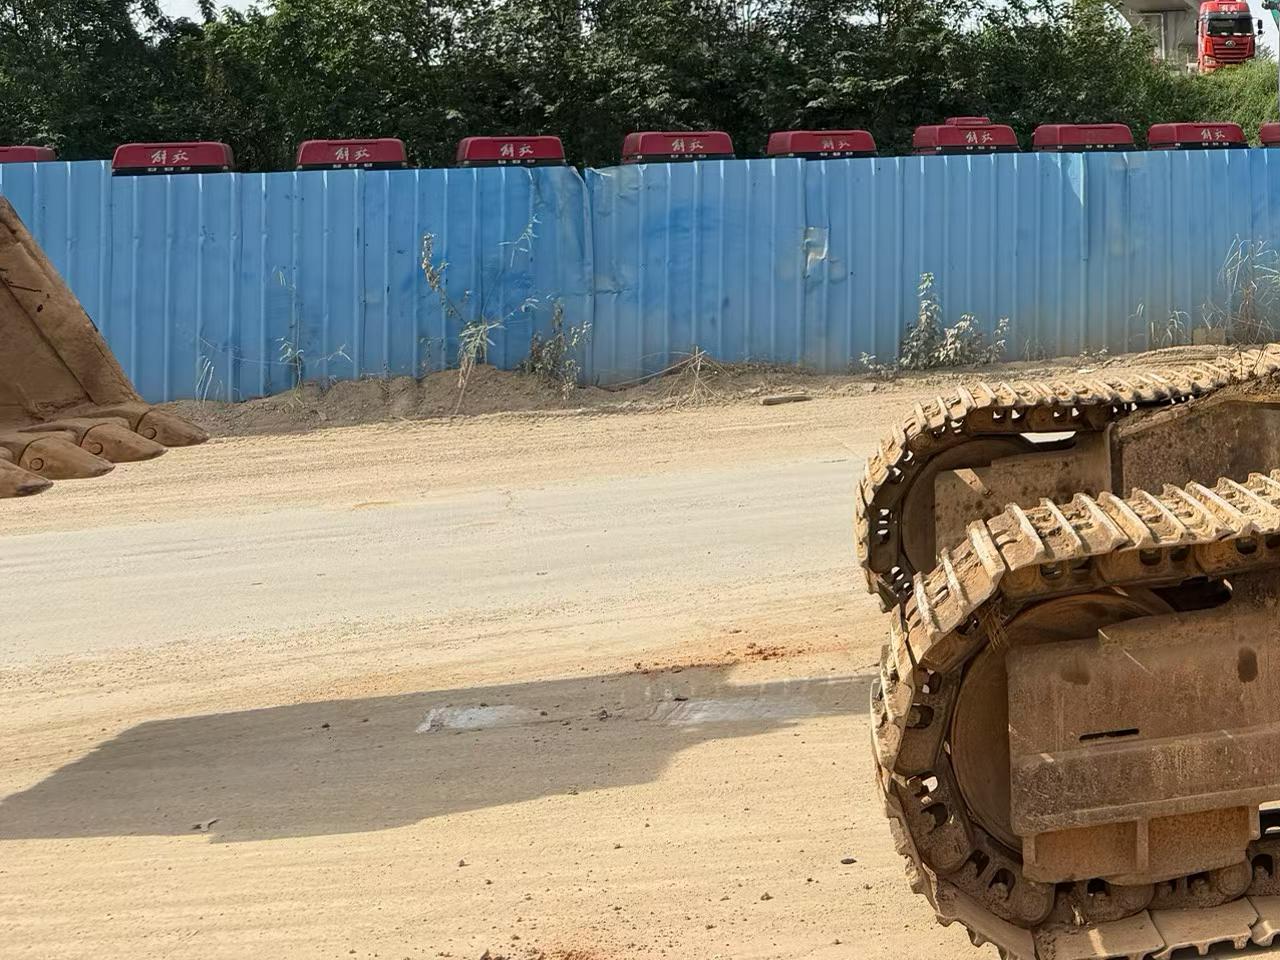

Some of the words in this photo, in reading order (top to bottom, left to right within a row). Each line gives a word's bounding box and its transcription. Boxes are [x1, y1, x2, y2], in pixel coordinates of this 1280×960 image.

[966, 131, 993, 143] 解放
[500, 143, 534, 157] 解放
[671, 139, 704, 153] 解放
[150, 150, 189, 164] 解放
[335, 147, 371, 161] 解放
